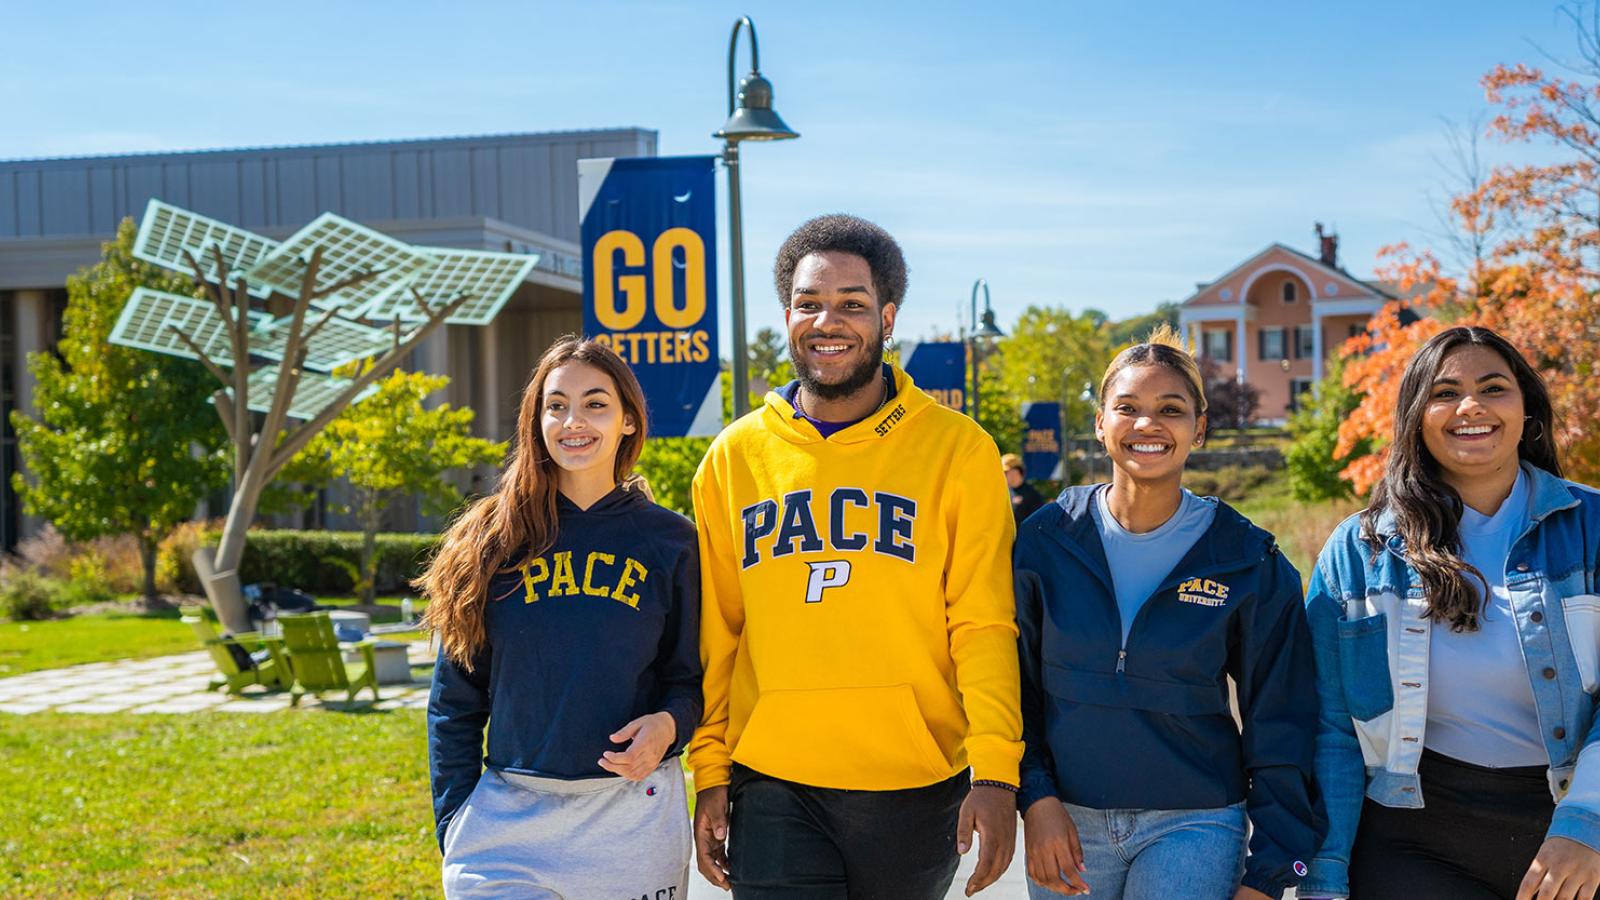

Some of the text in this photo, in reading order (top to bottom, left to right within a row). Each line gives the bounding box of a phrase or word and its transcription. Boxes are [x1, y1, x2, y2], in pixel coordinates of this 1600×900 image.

[593, 227, 706, 331] GO
[874, 403, 906, 437] SETTERS
[741, 487, 917, 570] PACE
[518, 551, 648, 608] PACE
[804, 559, 852, 604] P
[1177, 577, 1230, 599] PACE
[631, 886, 677, 900] CE
